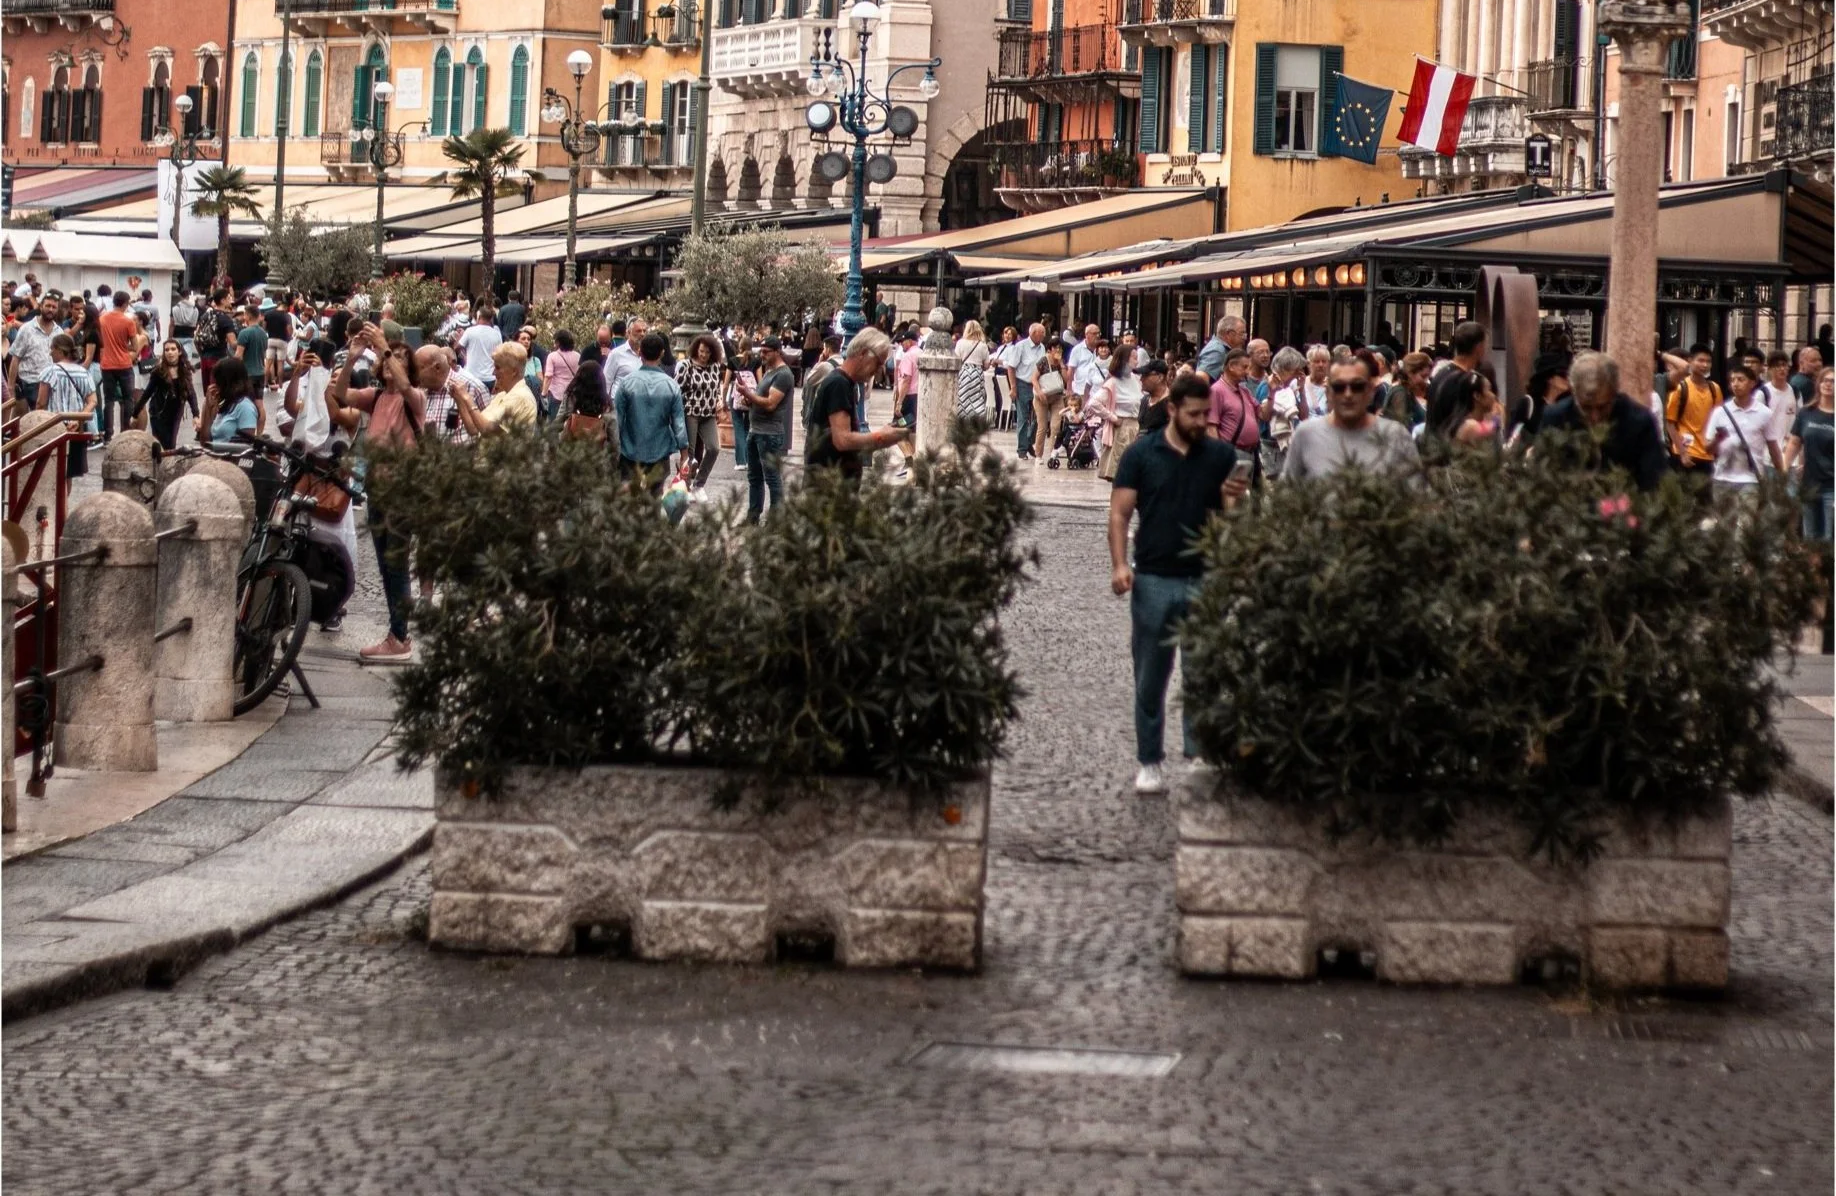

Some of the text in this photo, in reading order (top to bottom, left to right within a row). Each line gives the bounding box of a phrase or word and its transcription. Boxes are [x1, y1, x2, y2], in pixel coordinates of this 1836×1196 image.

[27, 148, 39, 157] PER
[74, 148, 103, 157] TURISMO
[133, 147, 157, 156] VIAGGI
[1530, 142, 1548, 165] T
